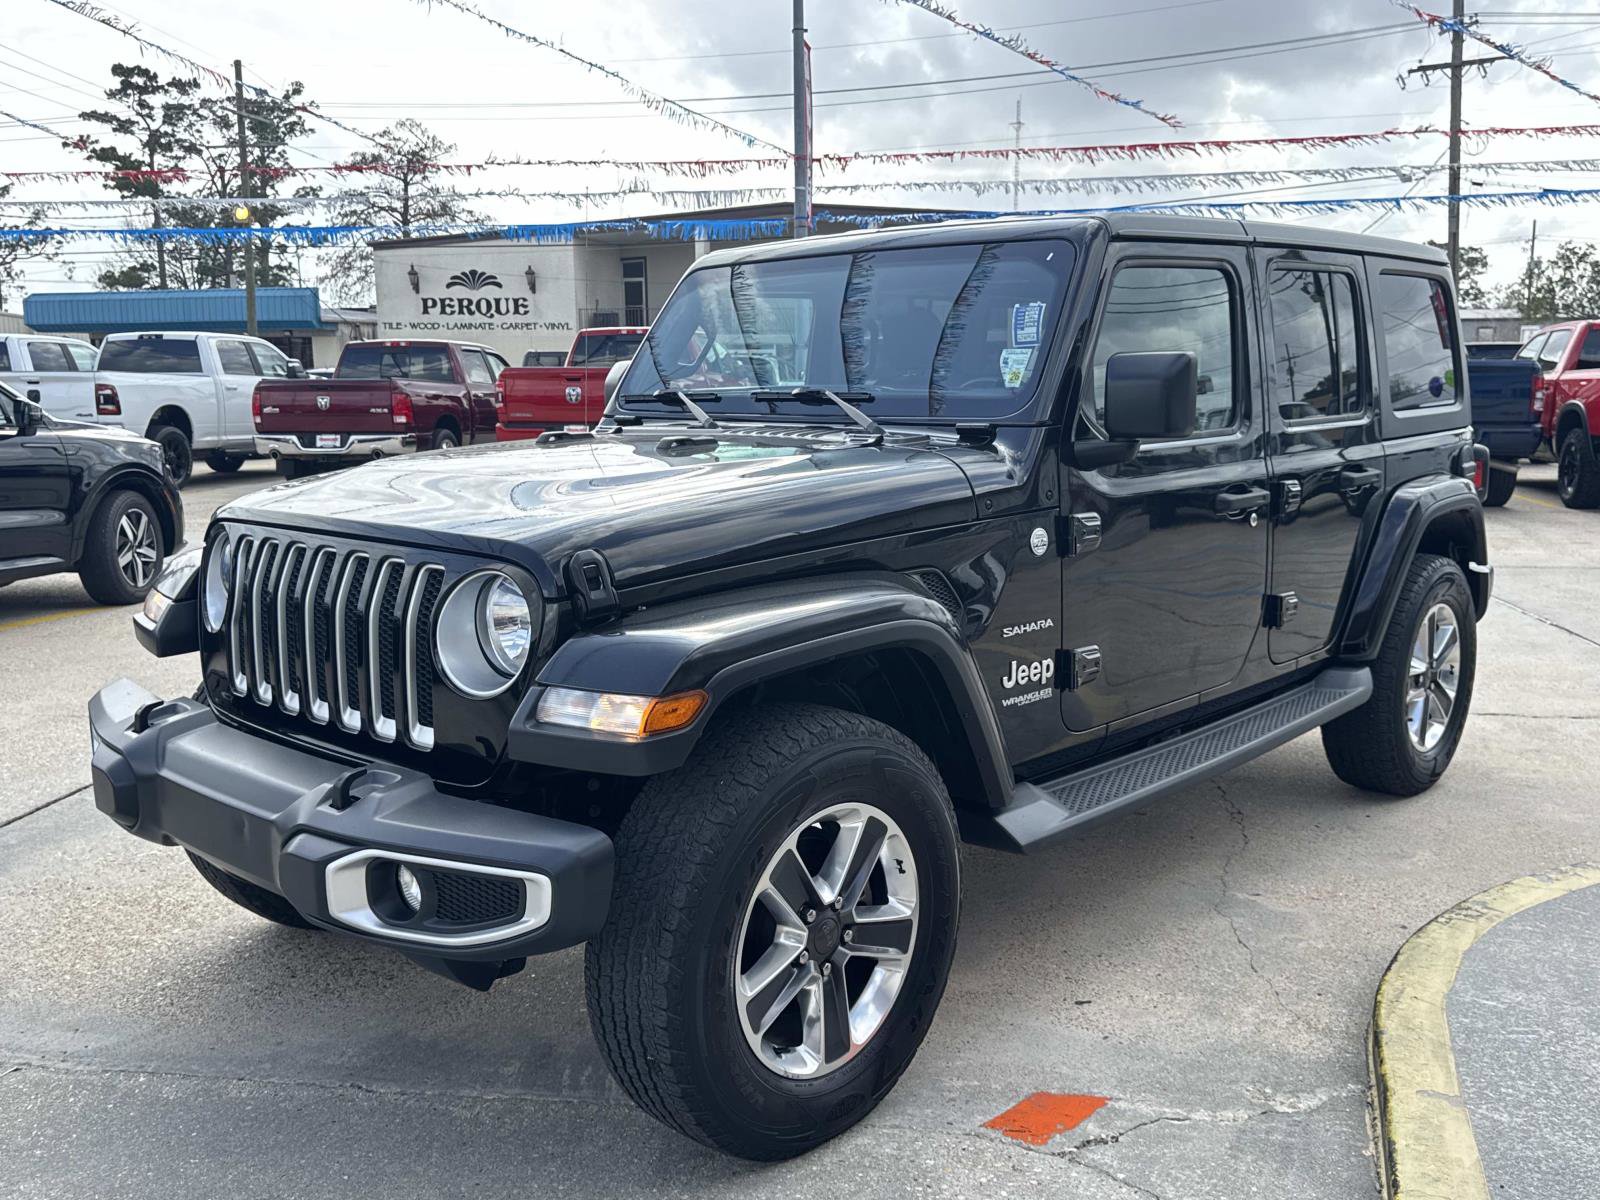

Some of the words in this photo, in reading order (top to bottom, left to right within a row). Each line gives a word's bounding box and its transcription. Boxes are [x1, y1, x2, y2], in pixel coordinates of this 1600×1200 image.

[421, 297, 530, 318] PERQUE
[383, 322, 402, 330] TILE
[408, 322, 440, 330] WOOD
[446, 322, 495, 331] LAMINATE
[501, 322, 538, 331] CARPET
[543, 323, 572, 331] VINYL
[1003, 619, 1054, 637] SAHARA
[1003, 658, 1054, 688] Jeep
[1002, 688, 1052, 707] WRANGLER
